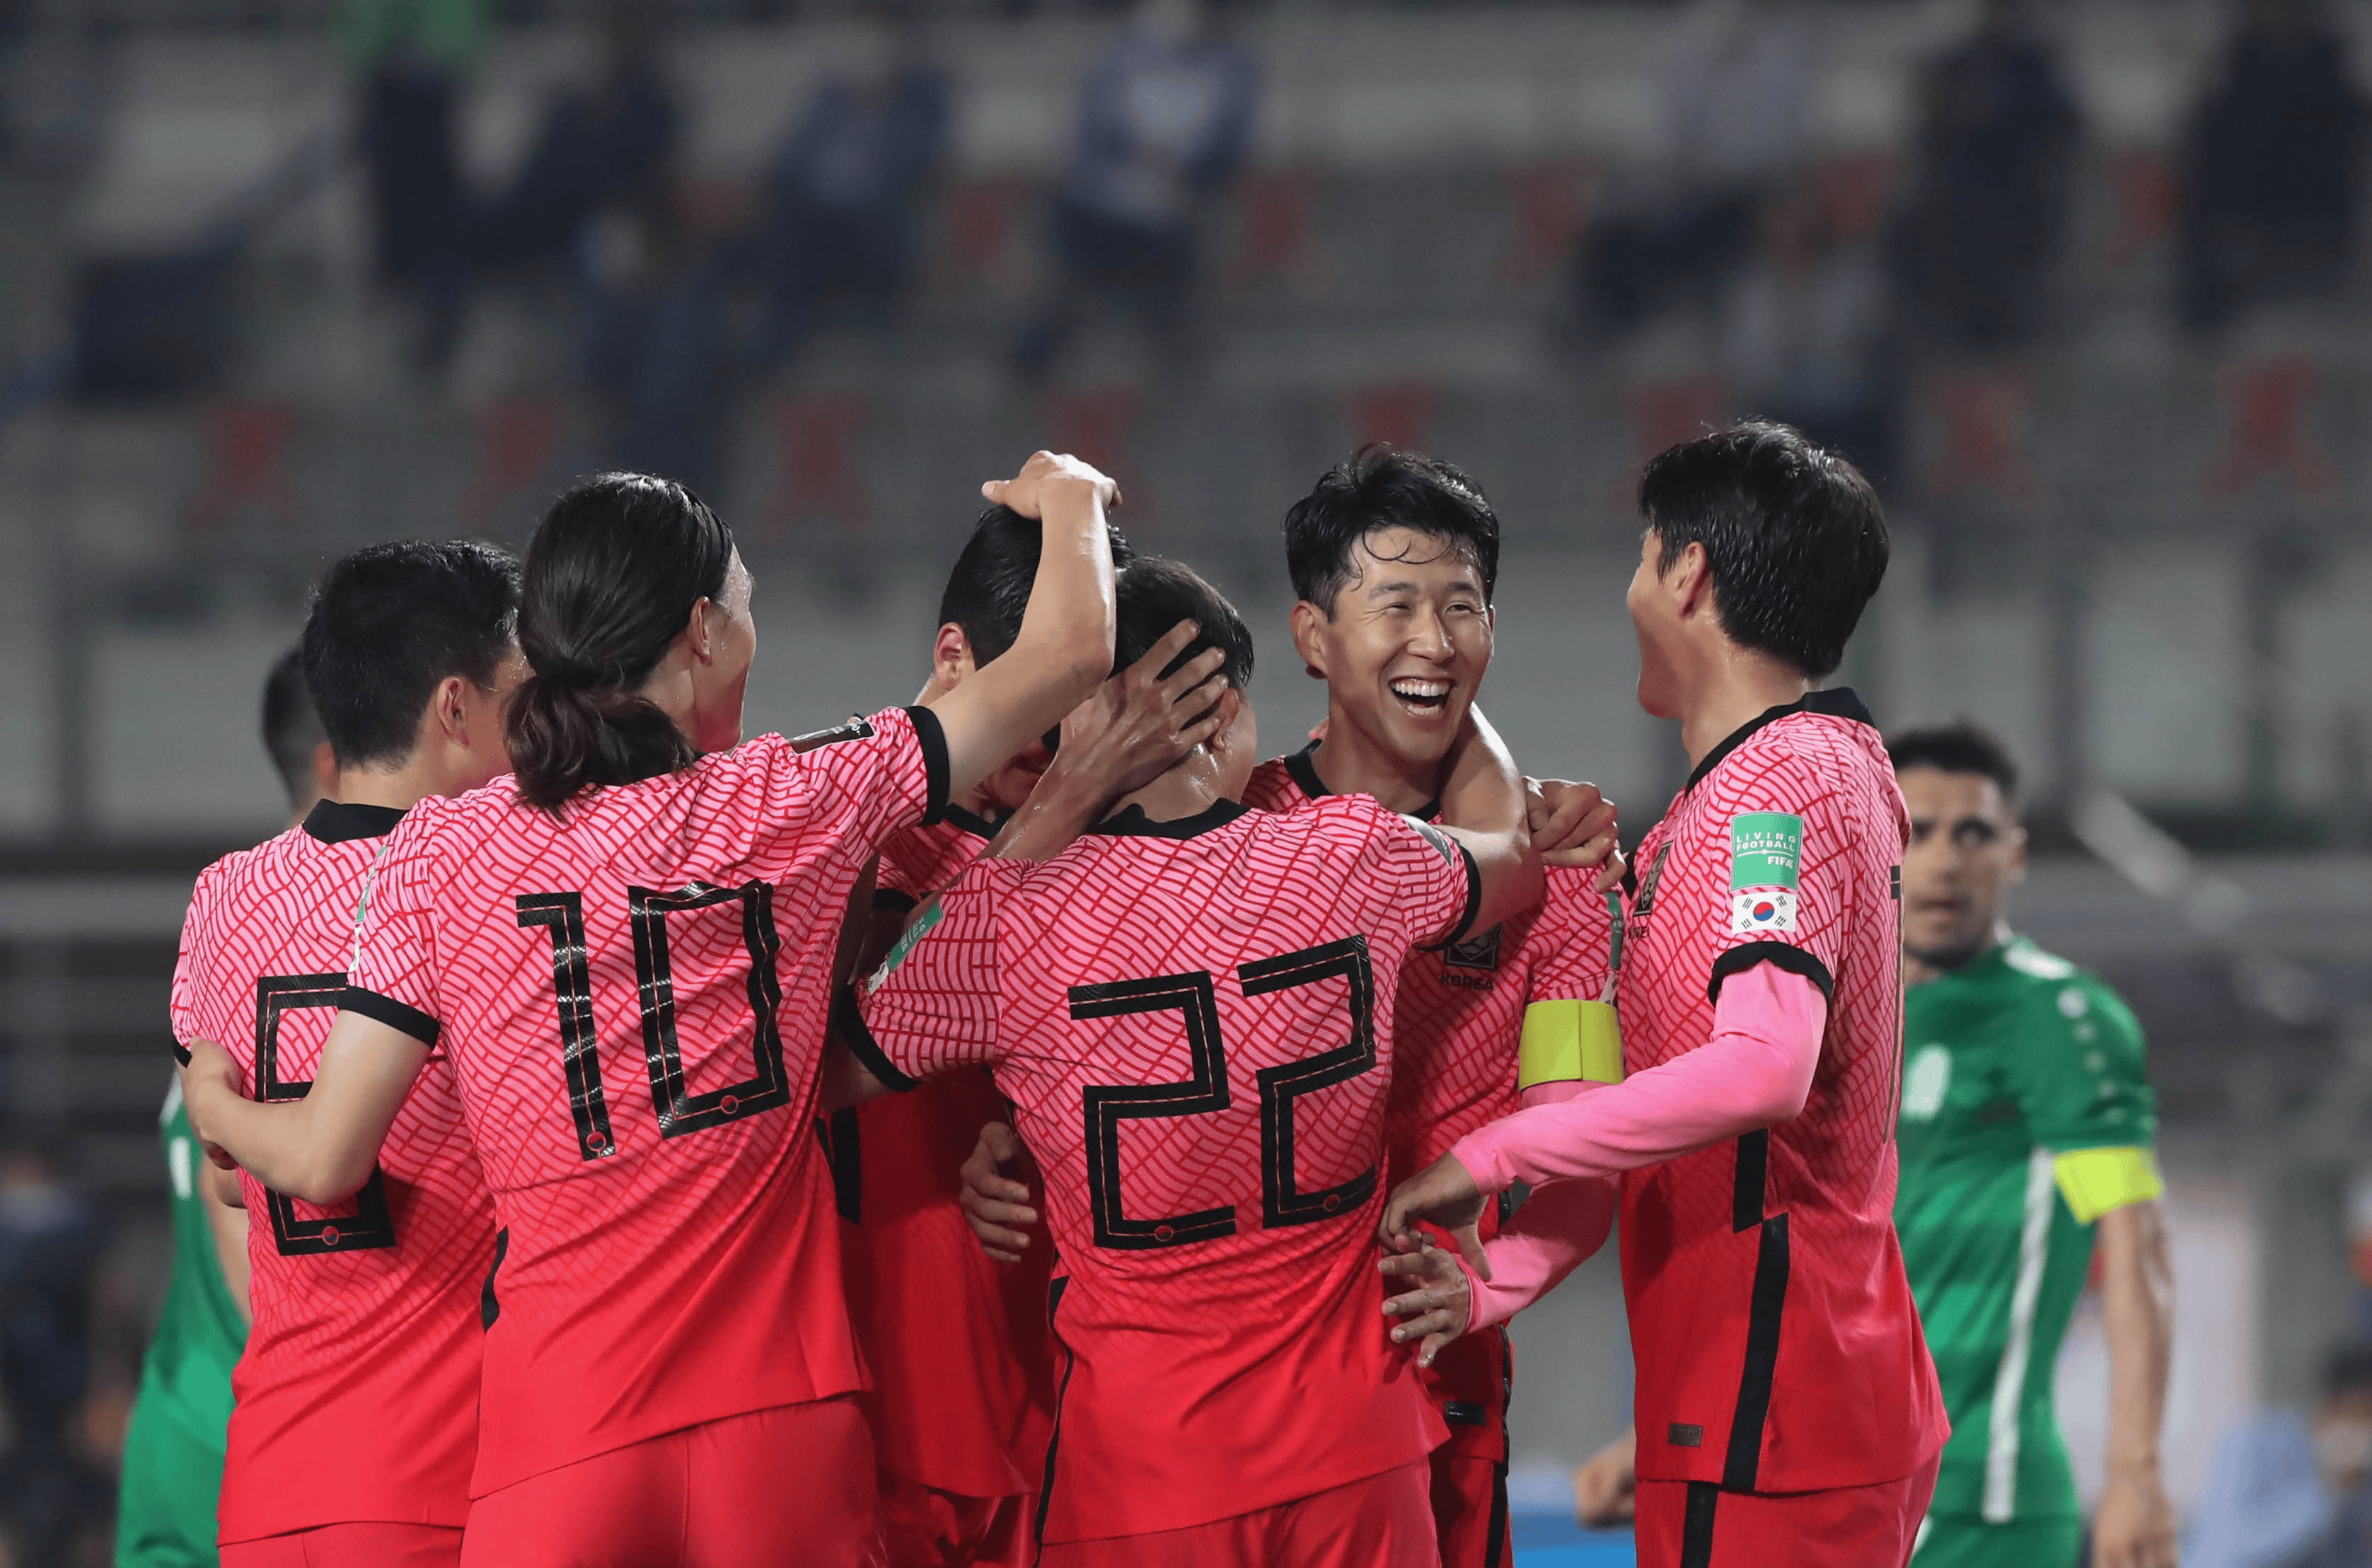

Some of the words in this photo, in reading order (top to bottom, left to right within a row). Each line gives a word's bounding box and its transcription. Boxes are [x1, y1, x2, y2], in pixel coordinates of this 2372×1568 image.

[1737, 832, 1795, 843] LIVING
[1737, 840, 1794, 852] FOOTBALL
[1767, 856, 1793, 869] FIFA
[1440, 974, 1494, 991] KOREA
[516, 878, 791, 1161] 10
[1067, 933, 1377, 1250] 22
